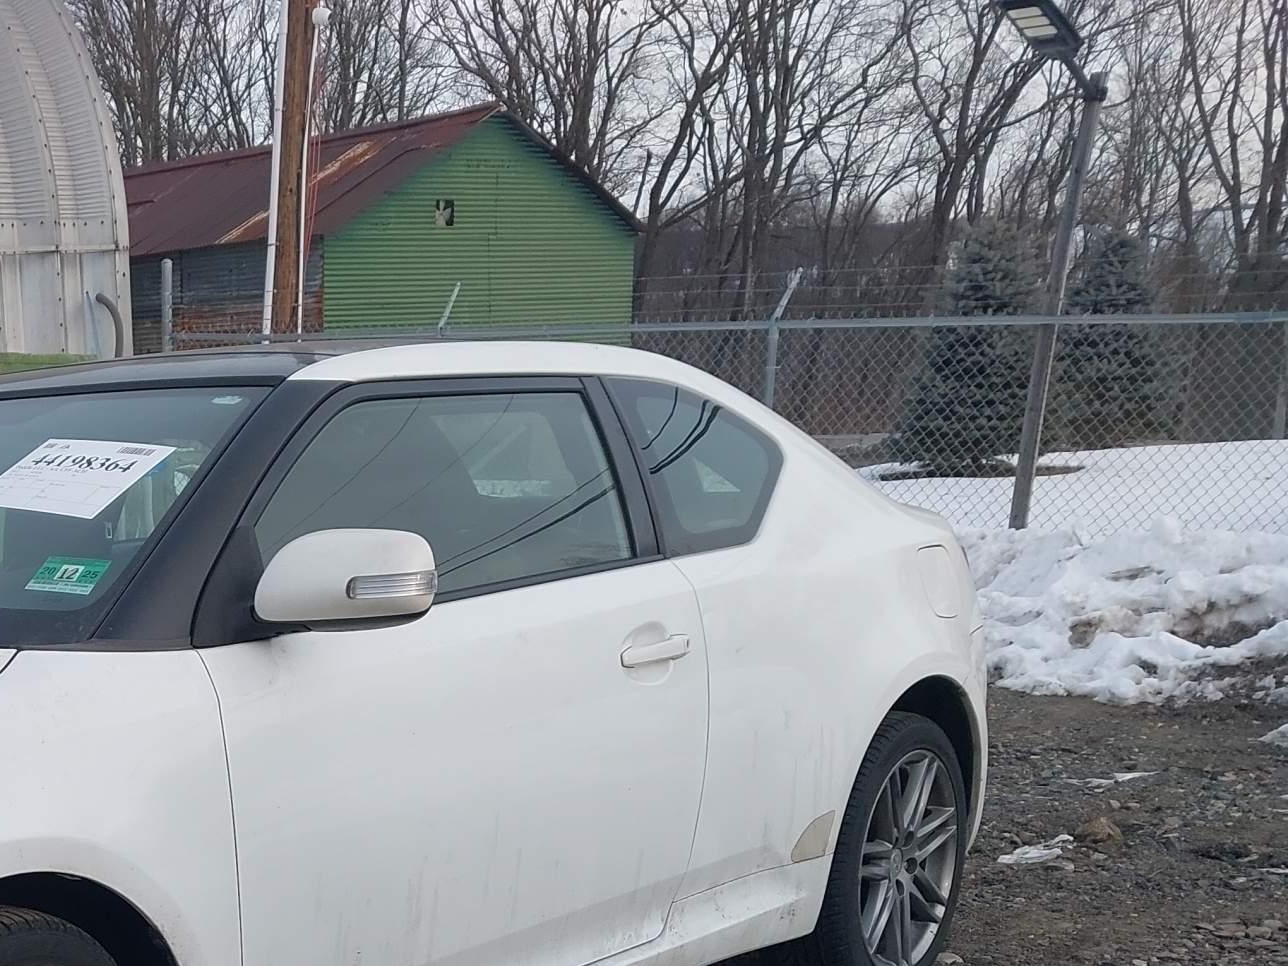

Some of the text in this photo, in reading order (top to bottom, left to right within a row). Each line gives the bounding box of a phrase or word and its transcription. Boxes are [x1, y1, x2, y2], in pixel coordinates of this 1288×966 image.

[32, 453, 138, 473] 44198364
[40, 566, 100, 580] 20 12 25
